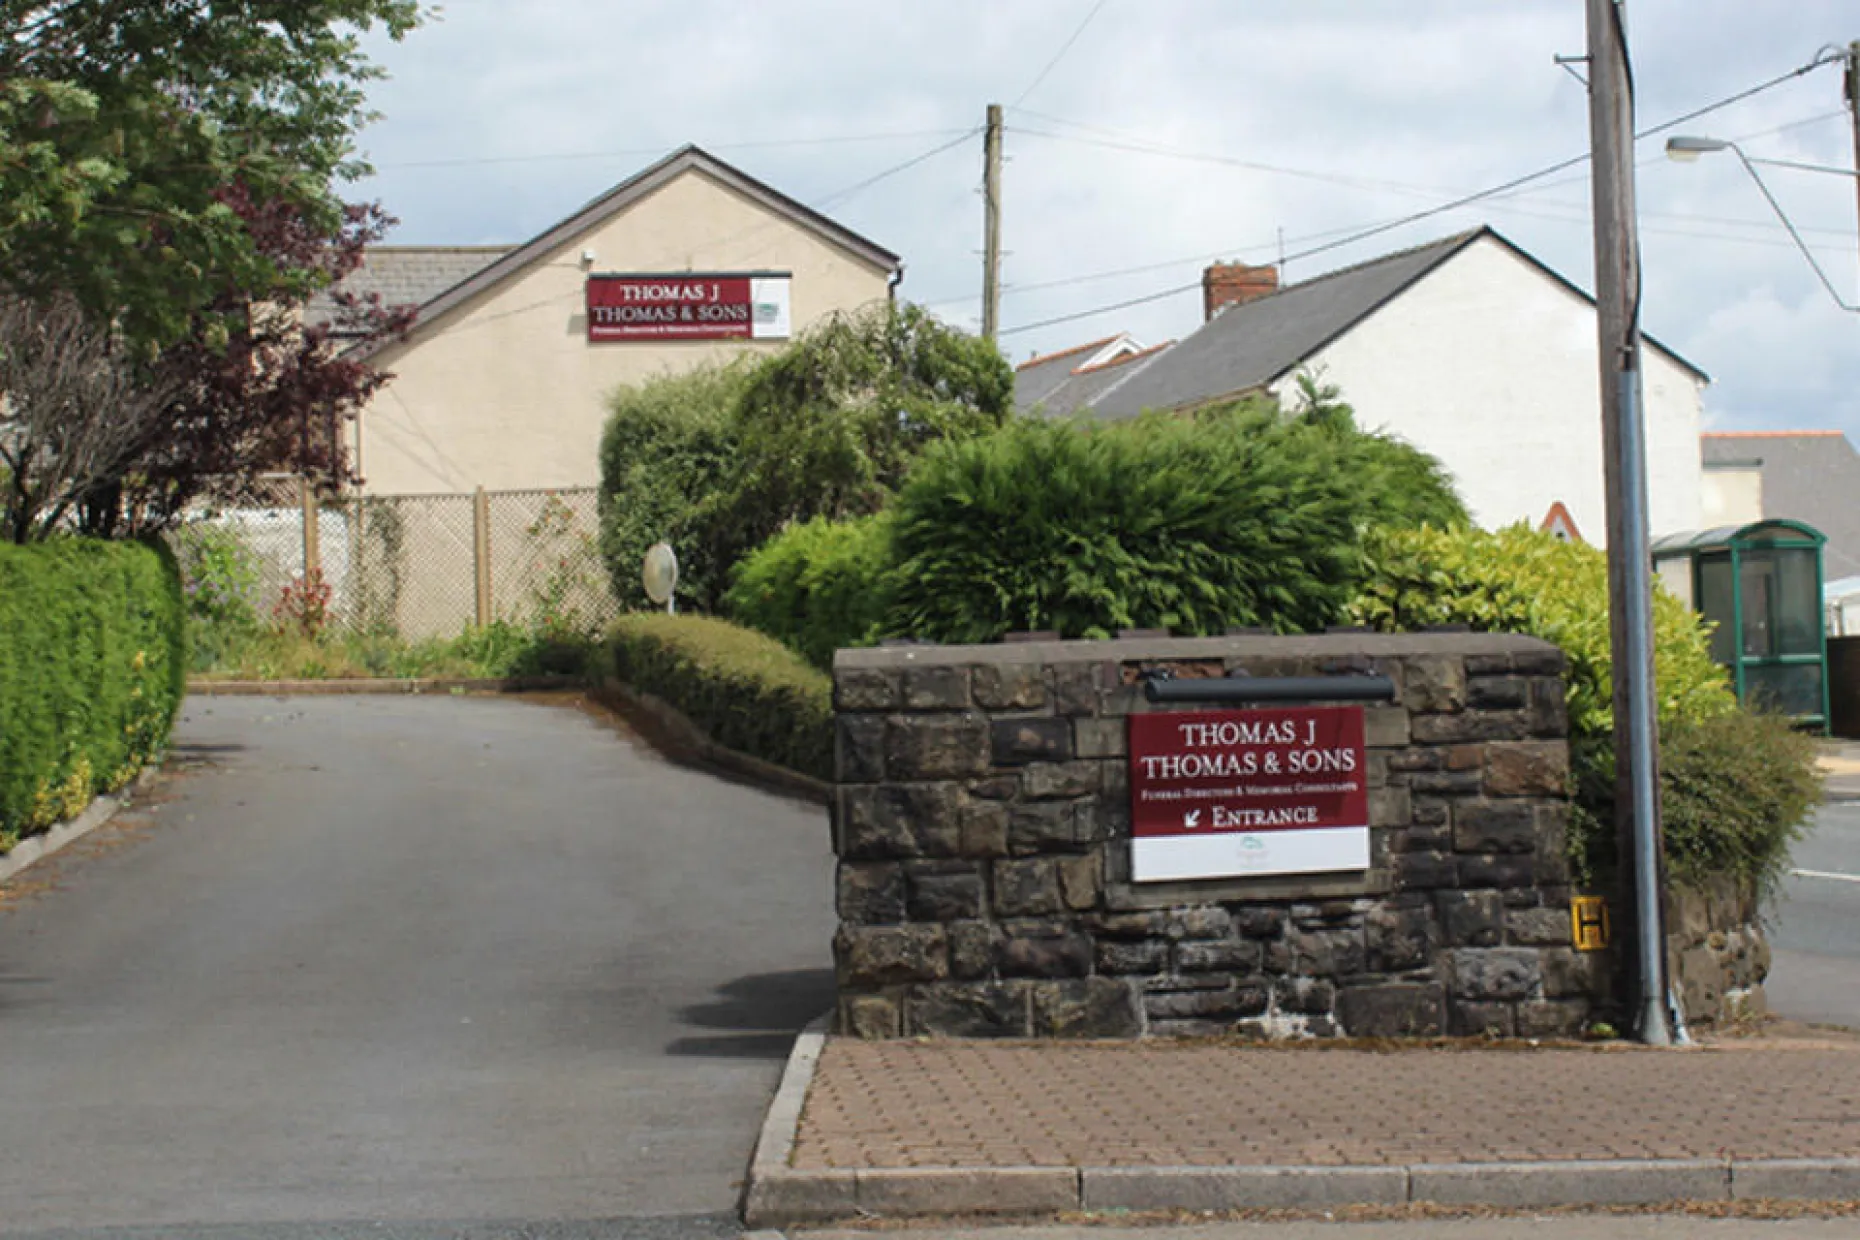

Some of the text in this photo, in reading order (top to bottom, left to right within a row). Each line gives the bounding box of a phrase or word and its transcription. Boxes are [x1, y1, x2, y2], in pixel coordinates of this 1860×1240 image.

[620, 284, 720, 302] THOMAS J
[593, 303, 748, 322] THOMAS & SONS
[1178, 720, 1316, 747] THOMAS J
[1140, 748, 1356, 779] THOMAS & SONS
[1212, 806, 1318, 828] ENTRANCE
